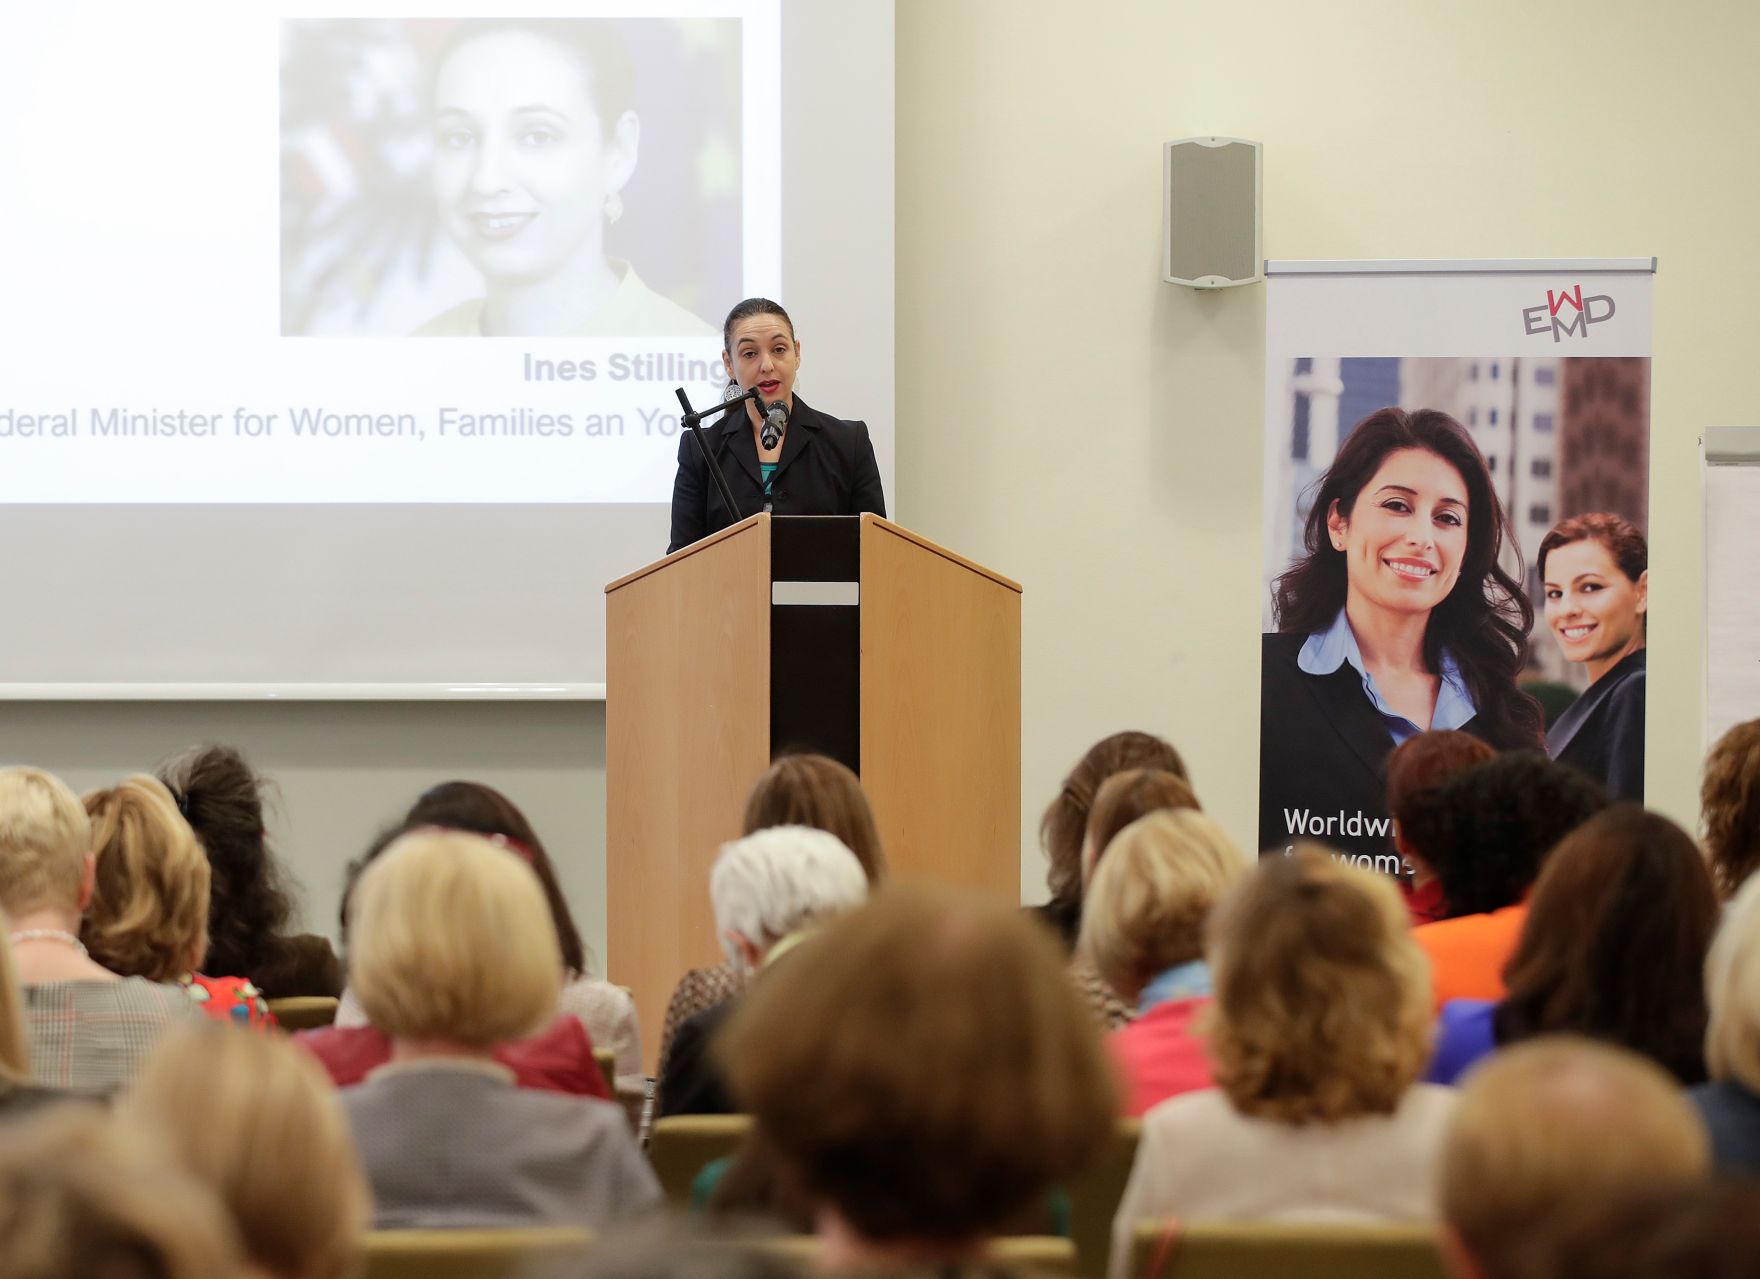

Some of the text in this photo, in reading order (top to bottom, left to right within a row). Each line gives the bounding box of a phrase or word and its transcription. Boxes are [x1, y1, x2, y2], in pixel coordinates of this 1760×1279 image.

[524, 353, 597, 382] Ines
[0, 408, 77, 437] deral
[90, 408, 223, 437] Minister
[233, 407, 279, 437] for
[289, 408, 426, 441] Women,
[438, 408, 574, 437] Families
[585, 414, 624, 437] an
